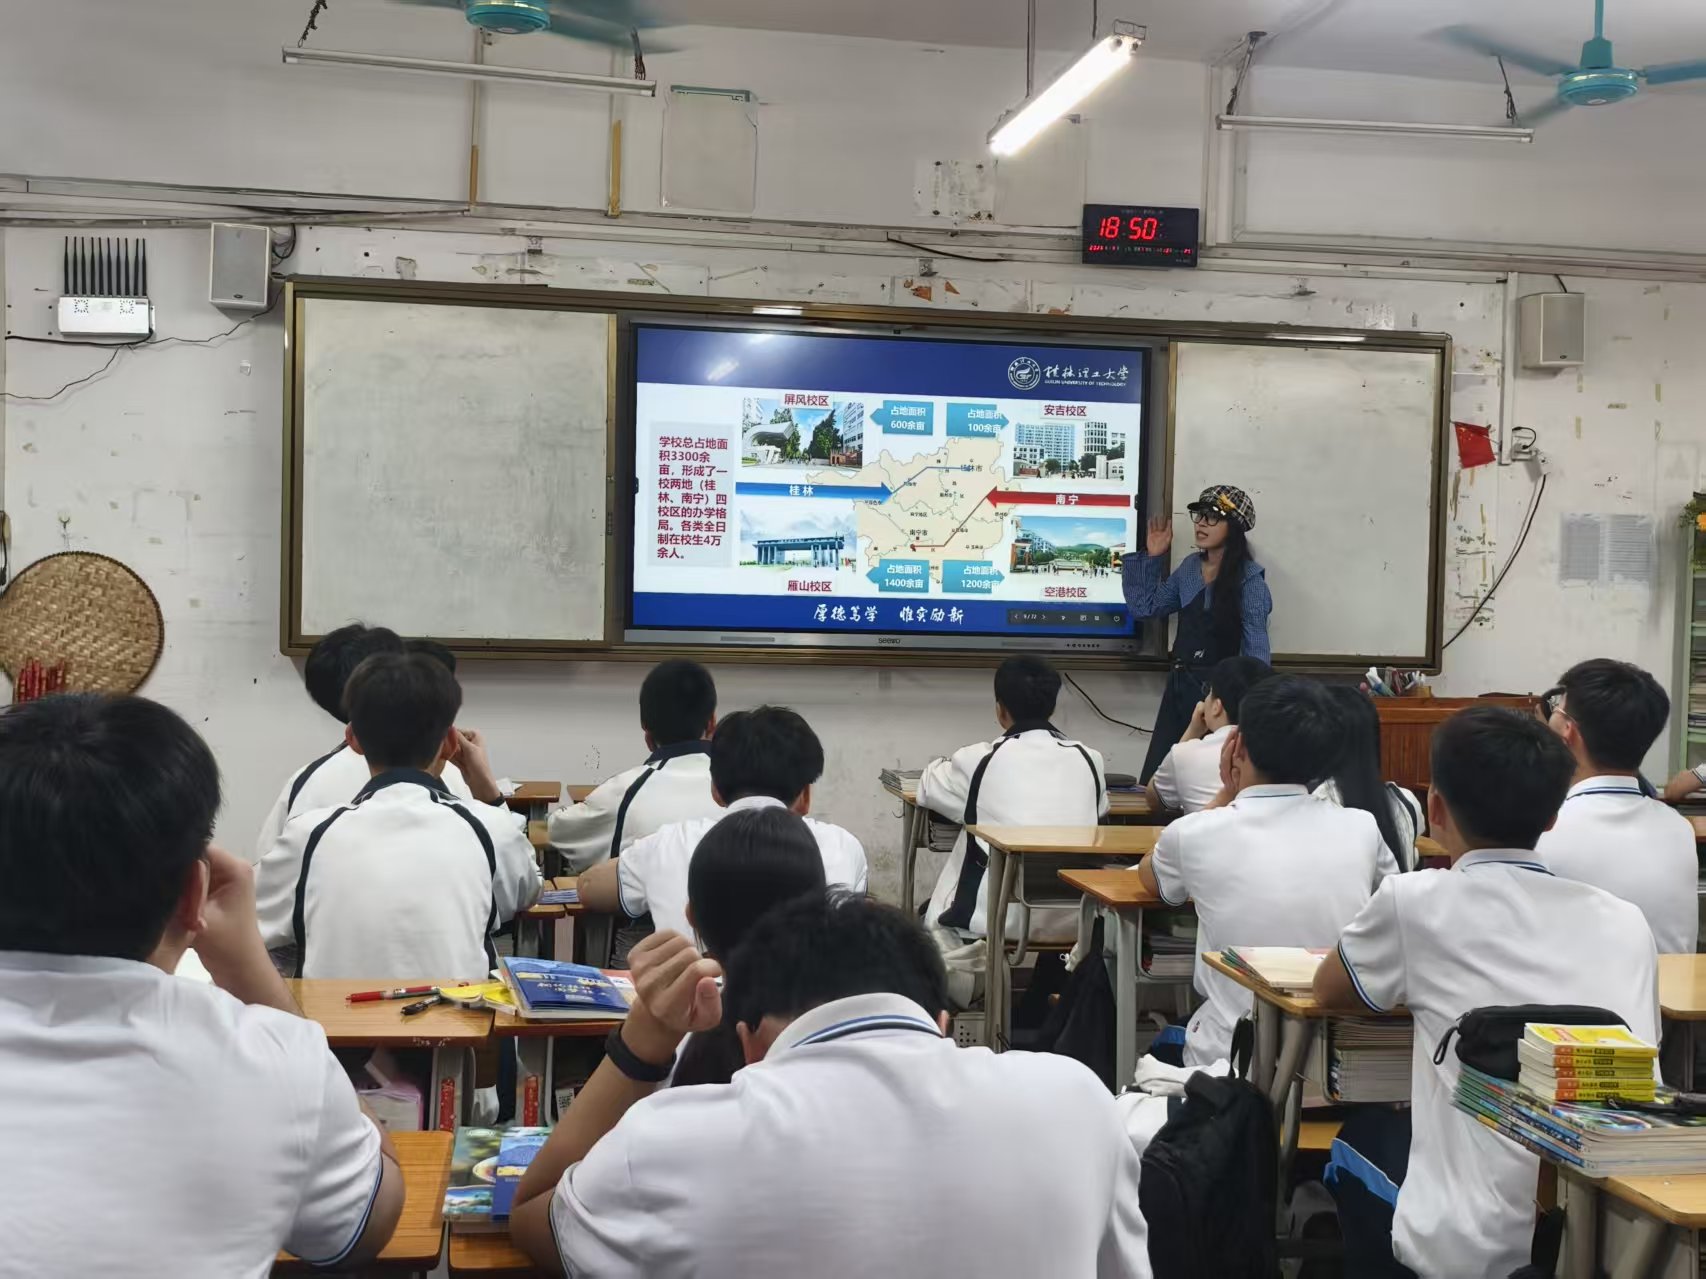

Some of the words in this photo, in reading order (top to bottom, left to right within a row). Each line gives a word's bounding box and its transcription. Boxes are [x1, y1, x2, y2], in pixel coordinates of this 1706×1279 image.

[1043, 364, 1129, 381] 桂林理工大学
[784, 393, 829, 407] 屏风校区
[890, 406, 926, 417] 占地面积
[967, 409, 1002, 419] 占地面积
[1044, 404, 1087, 416] 安吉校区
[890, 420, 925, 431] 600余亩
[967, 423, 1002, 433] 100余亩
[659, 436, 728, 450] 学校总占地面
[659, 450, 710, 463] 积3300余
[658, 464, 728, 477] 亩，形成了一
[789, 485, 813, 496] 桂林
[1056, 494, 1078, 505] 南宁
[658, 506, 727, 519] 校区的办学格
[657, 520, 726, 533] 局。各类全日
[657, 534, 721, 546] 制在校生4万
[657, 547, 685, 559] 余人。
[886, 564, 922, 575] 占地面积
[963, 566, 999, 576] 占地面积
[787, 580, 832, 592] 雁山校区
[884, 578, 923, 589] 1400余亩
[1044, 586, 1087, 598] 空港校区
[813, 603, 878, 622] 厚德笃学
[900, 606, 964, 625] 惟实励新
